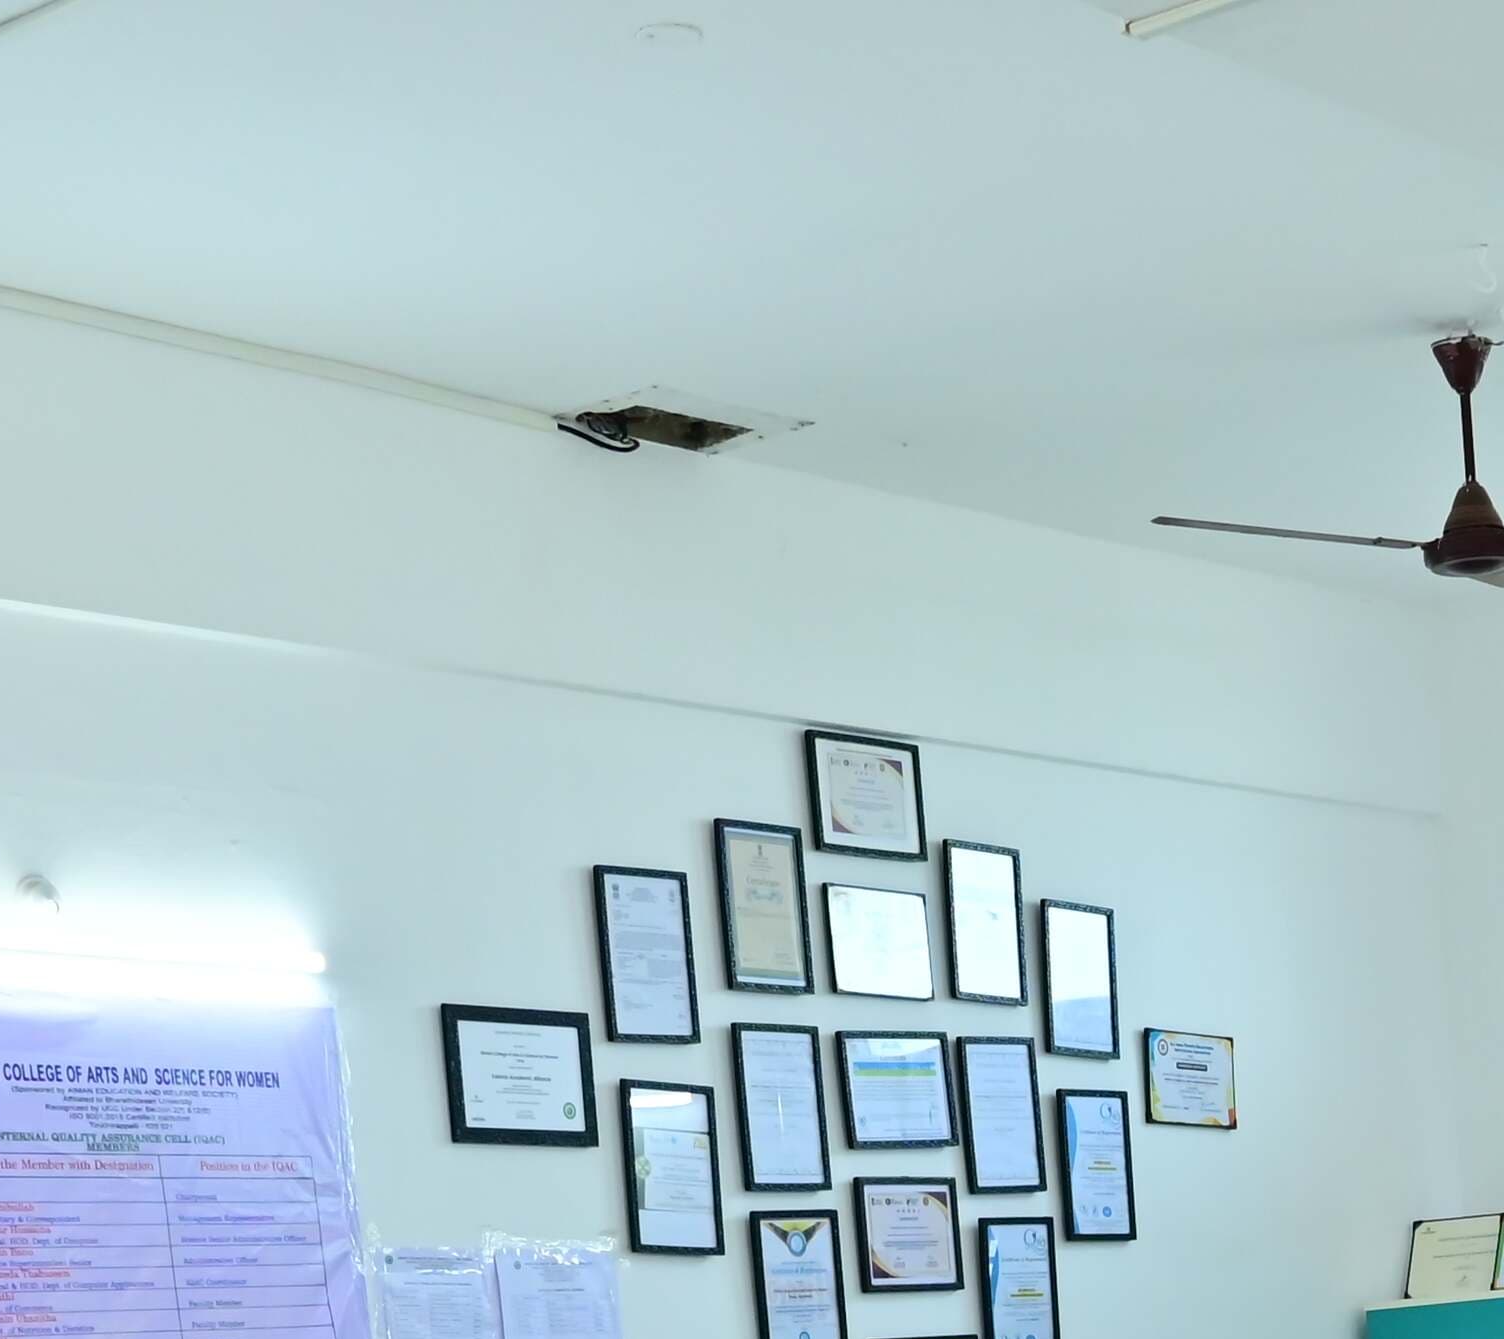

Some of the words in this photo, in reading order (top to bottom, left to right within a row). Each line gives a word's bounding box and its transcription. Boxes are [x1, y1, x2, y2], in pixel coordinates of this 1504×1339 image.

[3, 1063, 63, 1082] COLLEGE
[66, 1065, 83, 1083] OF
[87, 1066, 120, 1084] ARTS
[123, 1067, 148, 1085] AND
[155, 1068, 206, 1086] SCIENCE
[208, 1069, 234, 1087] FOR
[235, 1071, 280, 1089] WOMEN
[51, 1132, 97, 1143] QUALITY
[100, 1133, 162, 1144] ASSURANCE
[164, 1134, 192, 1144] CELL
[87, 1143, 140, 1151] MEMBERS
[0, 1158, 17, 1170] the
[21, 1159, 64, 1170] Member
[68, 1159, 91, 1170] with
[200, 1161, 239, 1171] Position
[253, 1161, 271, 1172] the
